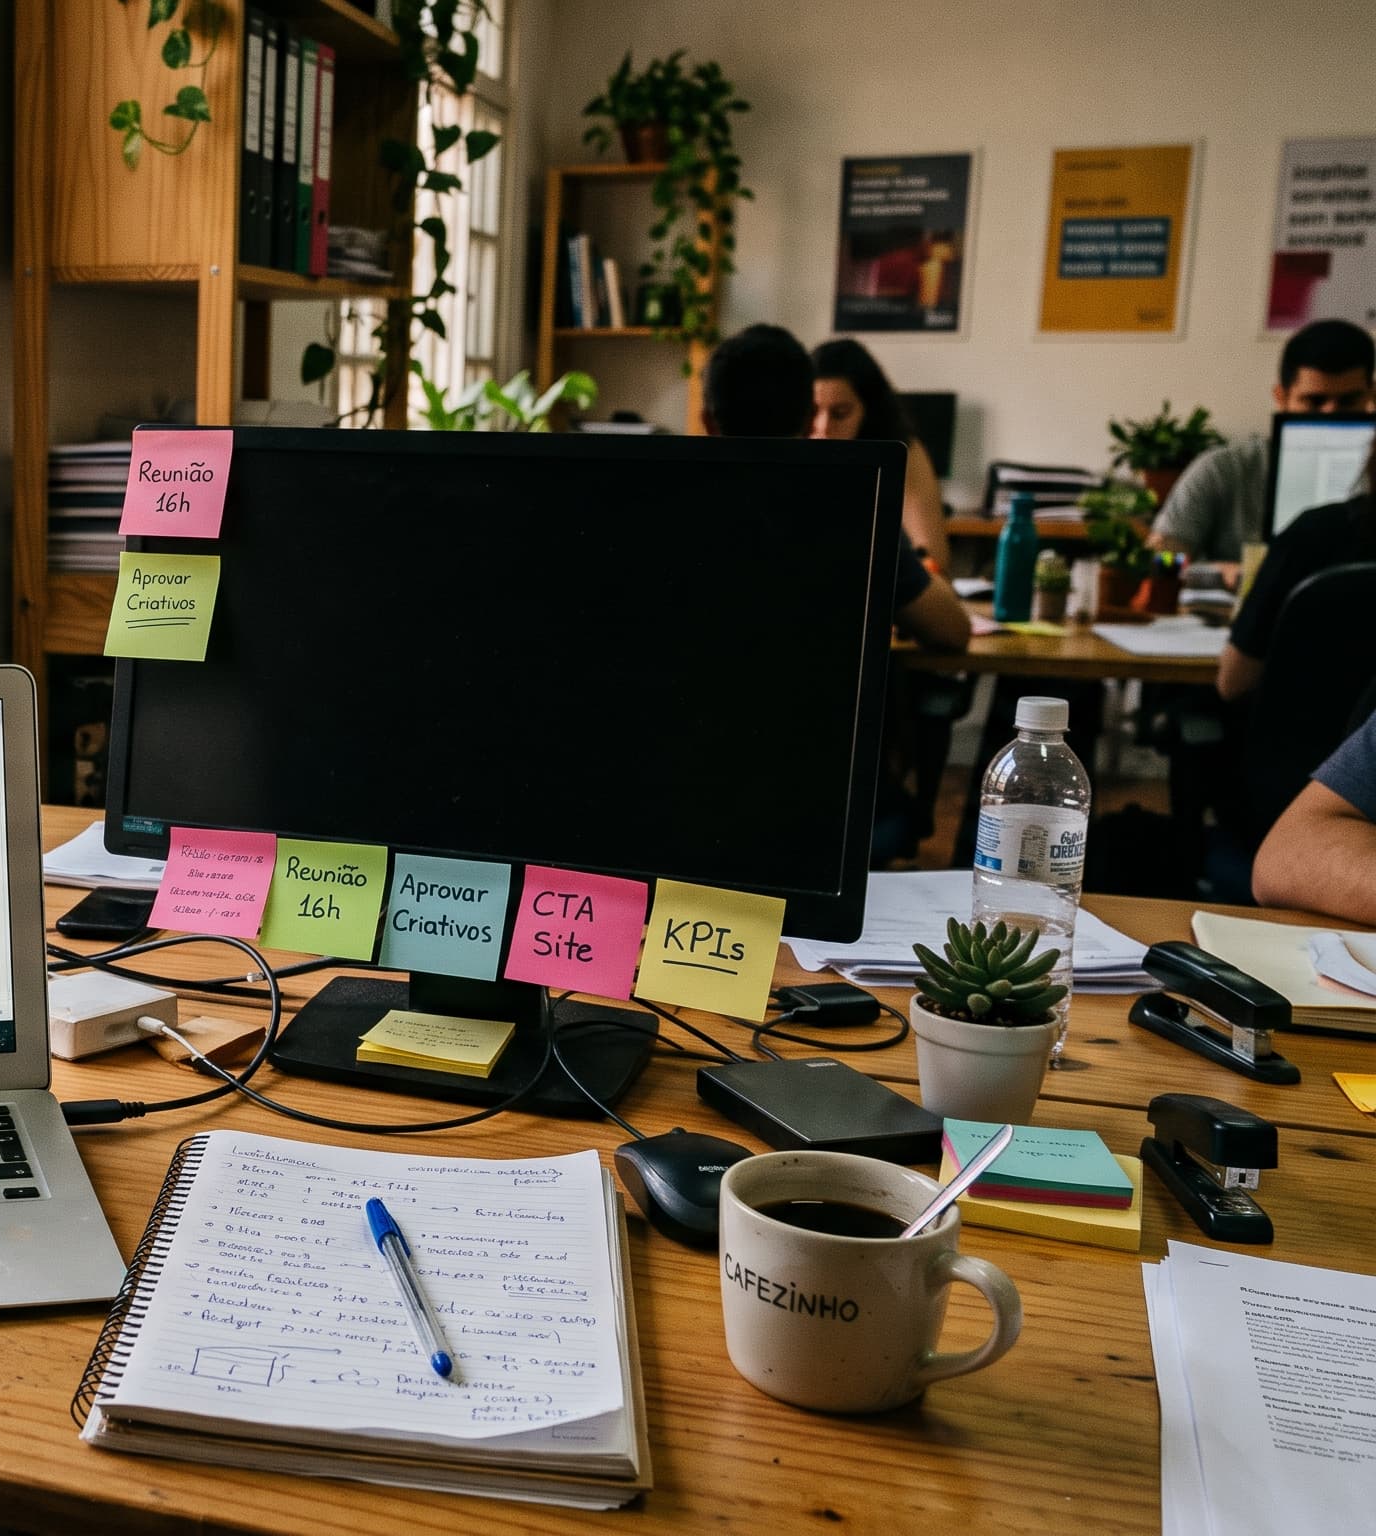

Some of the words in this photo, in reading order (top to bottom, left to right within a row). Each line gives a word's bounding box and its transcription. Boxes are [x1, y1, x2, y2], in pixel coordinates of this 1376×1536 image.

[139, 461, 213, 482] Reunião
[156, 492, 189, 512] 16h
[133, 569, 191, 590] Aprovar
[127, 594, 195, 610] Criativos
[287, 856, 367, 886] Reunião
[400, 874, 488, 902] Aprovar
[298, 894, 339, 919] 16h
[533, 891, 593, 922] CTA
[393, 909, 491, 942] Criativos
[663, 918, 744, 961] KPIs
[534, 932, 592, 962] Site
